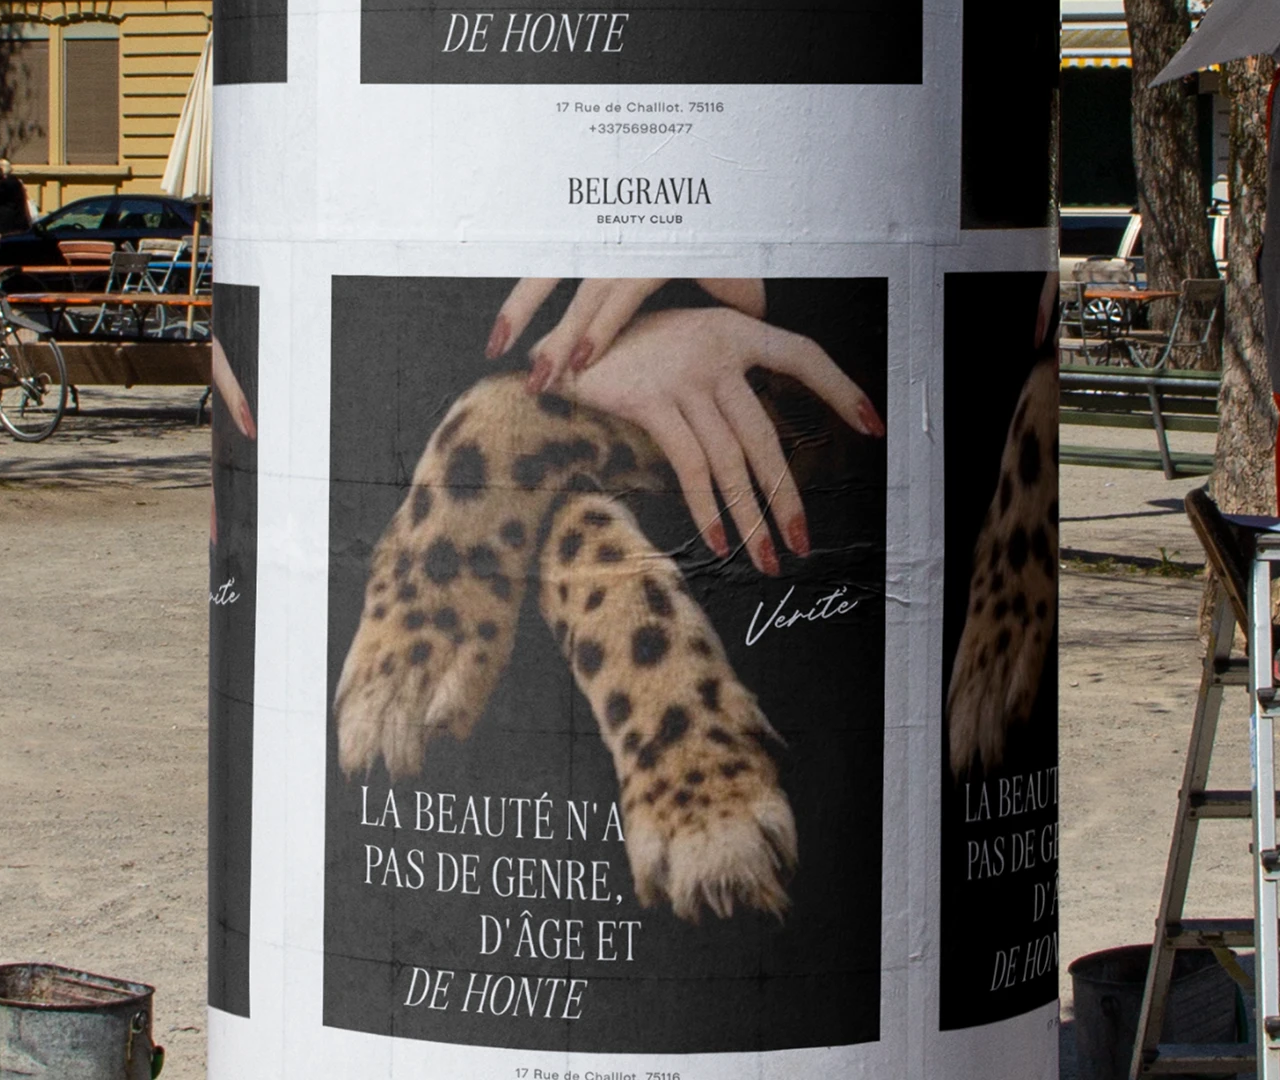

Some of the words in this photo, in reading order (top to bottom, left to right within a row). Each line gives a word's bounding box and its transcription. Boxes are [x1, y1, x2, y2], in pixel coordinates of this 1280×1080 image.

[442, 14, 494, 52] DE
[500, 13, 629, 52] HONTE
[557, 102, 569, 112] 17
[575, 102, 600, 112] Rue
[605, 103, 621, 112] de
[689, 102, 724, 112] 75116
[590, 124, 692, 133] +33756980477
[569, 178, 711, 204] BELGRAVIA
[597, 215, 645, 224] BEAUTY
[650, 215, 682, 224] CLUB
[361, 786, 402, 828] LA
[414, 791, 554, 839] BEAUTÉ
[566, 801, 625, 842] N'A
[966, 782, 991, 822] LA
[365, 844, 424, 889] PAS
[437, 852, 480, 894] DE
[492, 856, 622, 904] GENRE,
[968, 836, 1004, 880] PAS
[1012, 829, 1035, 872] DE
[480, 910, 584, 959] D'ÂGE
[597, 921, 641, 961] ET
[990, 946, 1020, 991] DE
[404, 967, 454, 1010] DE
[461, 973, 588, 1019] HONTE
[516, 1068, 528, 1078] 17
[534, 1069, 559, 1080] Rue
[564, 1071, 579, 1080] de
